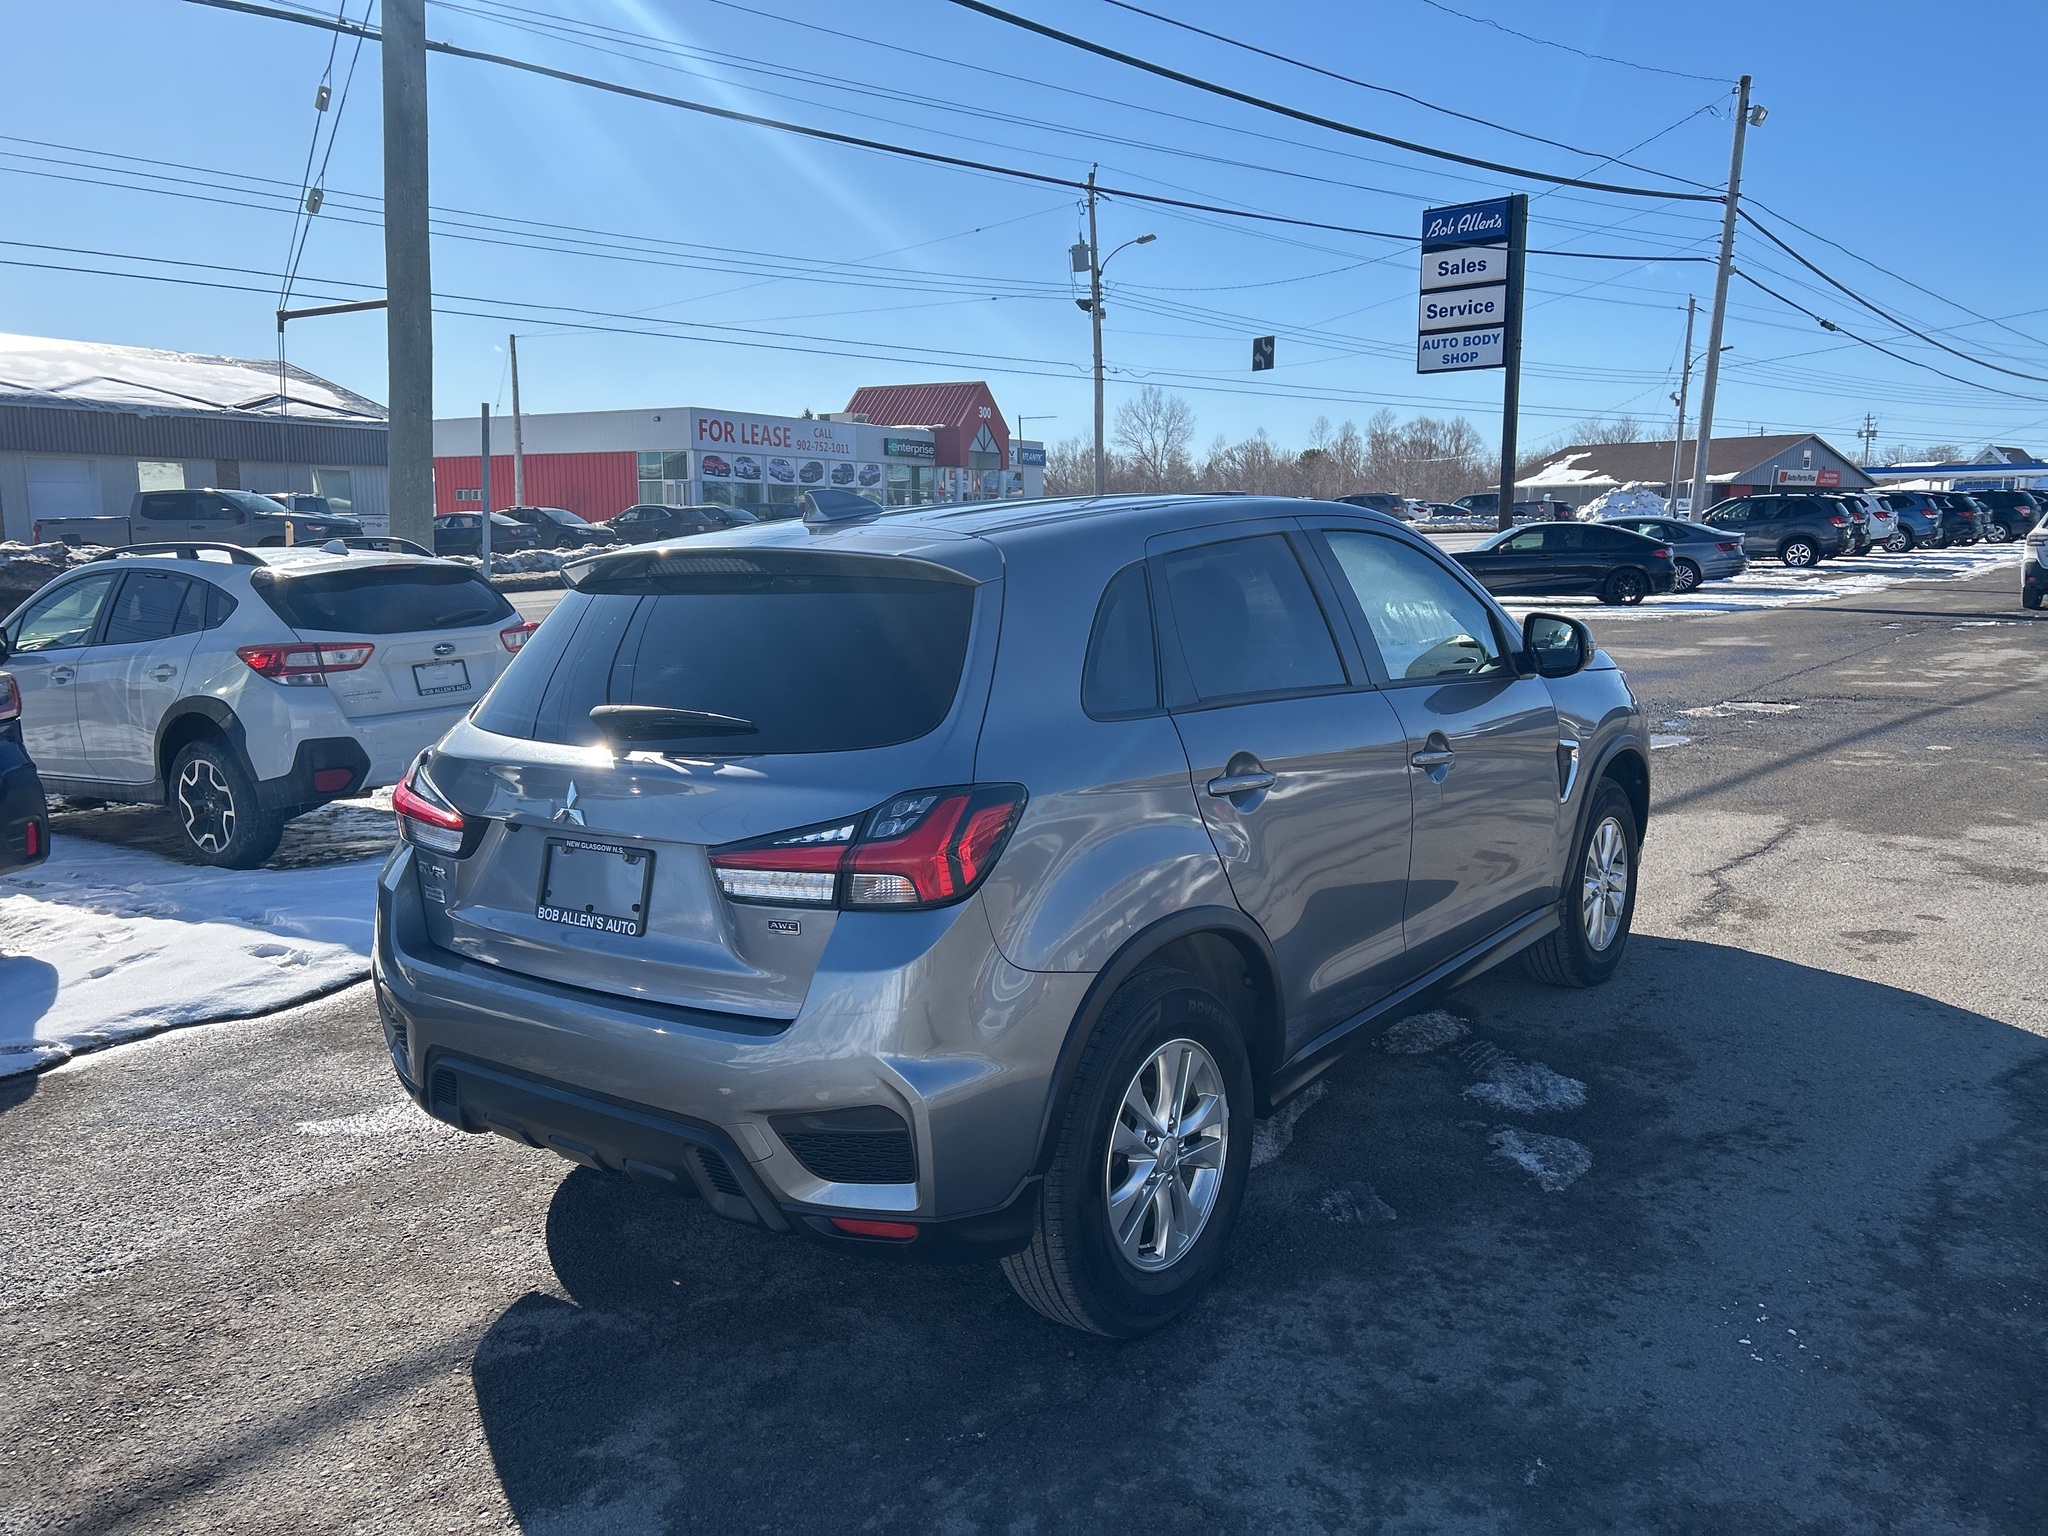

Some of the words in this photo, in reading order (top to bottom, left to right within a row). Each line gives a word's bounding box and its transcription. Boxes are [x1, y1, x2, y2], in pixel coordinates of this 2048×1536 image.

[1426, 217, 1454, 238] Bob
[1457, 212, 1502, 234] Allen's
[1437, 258, 1487, 277] Sales
[1426, 299, 1495, 319] Service
[1422, 337, 1459, 350] AUTO
[1463, 333, 1501, 347] BODY
[1441, 352, 1479, 364] SHOP
[978, 406, 992, 419] 300
[698, 418, 736, 443] FOR
[741, 423, 792, 448] LEASE
[813, 427, 833, 439] CALL
[796, 440, 850, 454] 902-752-1011
[889, 443, 935, 456] enterprise
[434, 686, 456, 694] ALLEN'S
[456, 683, 471, 691] AUTO
[566, 840, 581, 848] NEW
[580, 841, 614, 852] GLASGOW
[537, 906, 560, 921] BOB
[560, 911, 604, 930] ALLEN'S
[605, 918, 637, 936] AUTO
